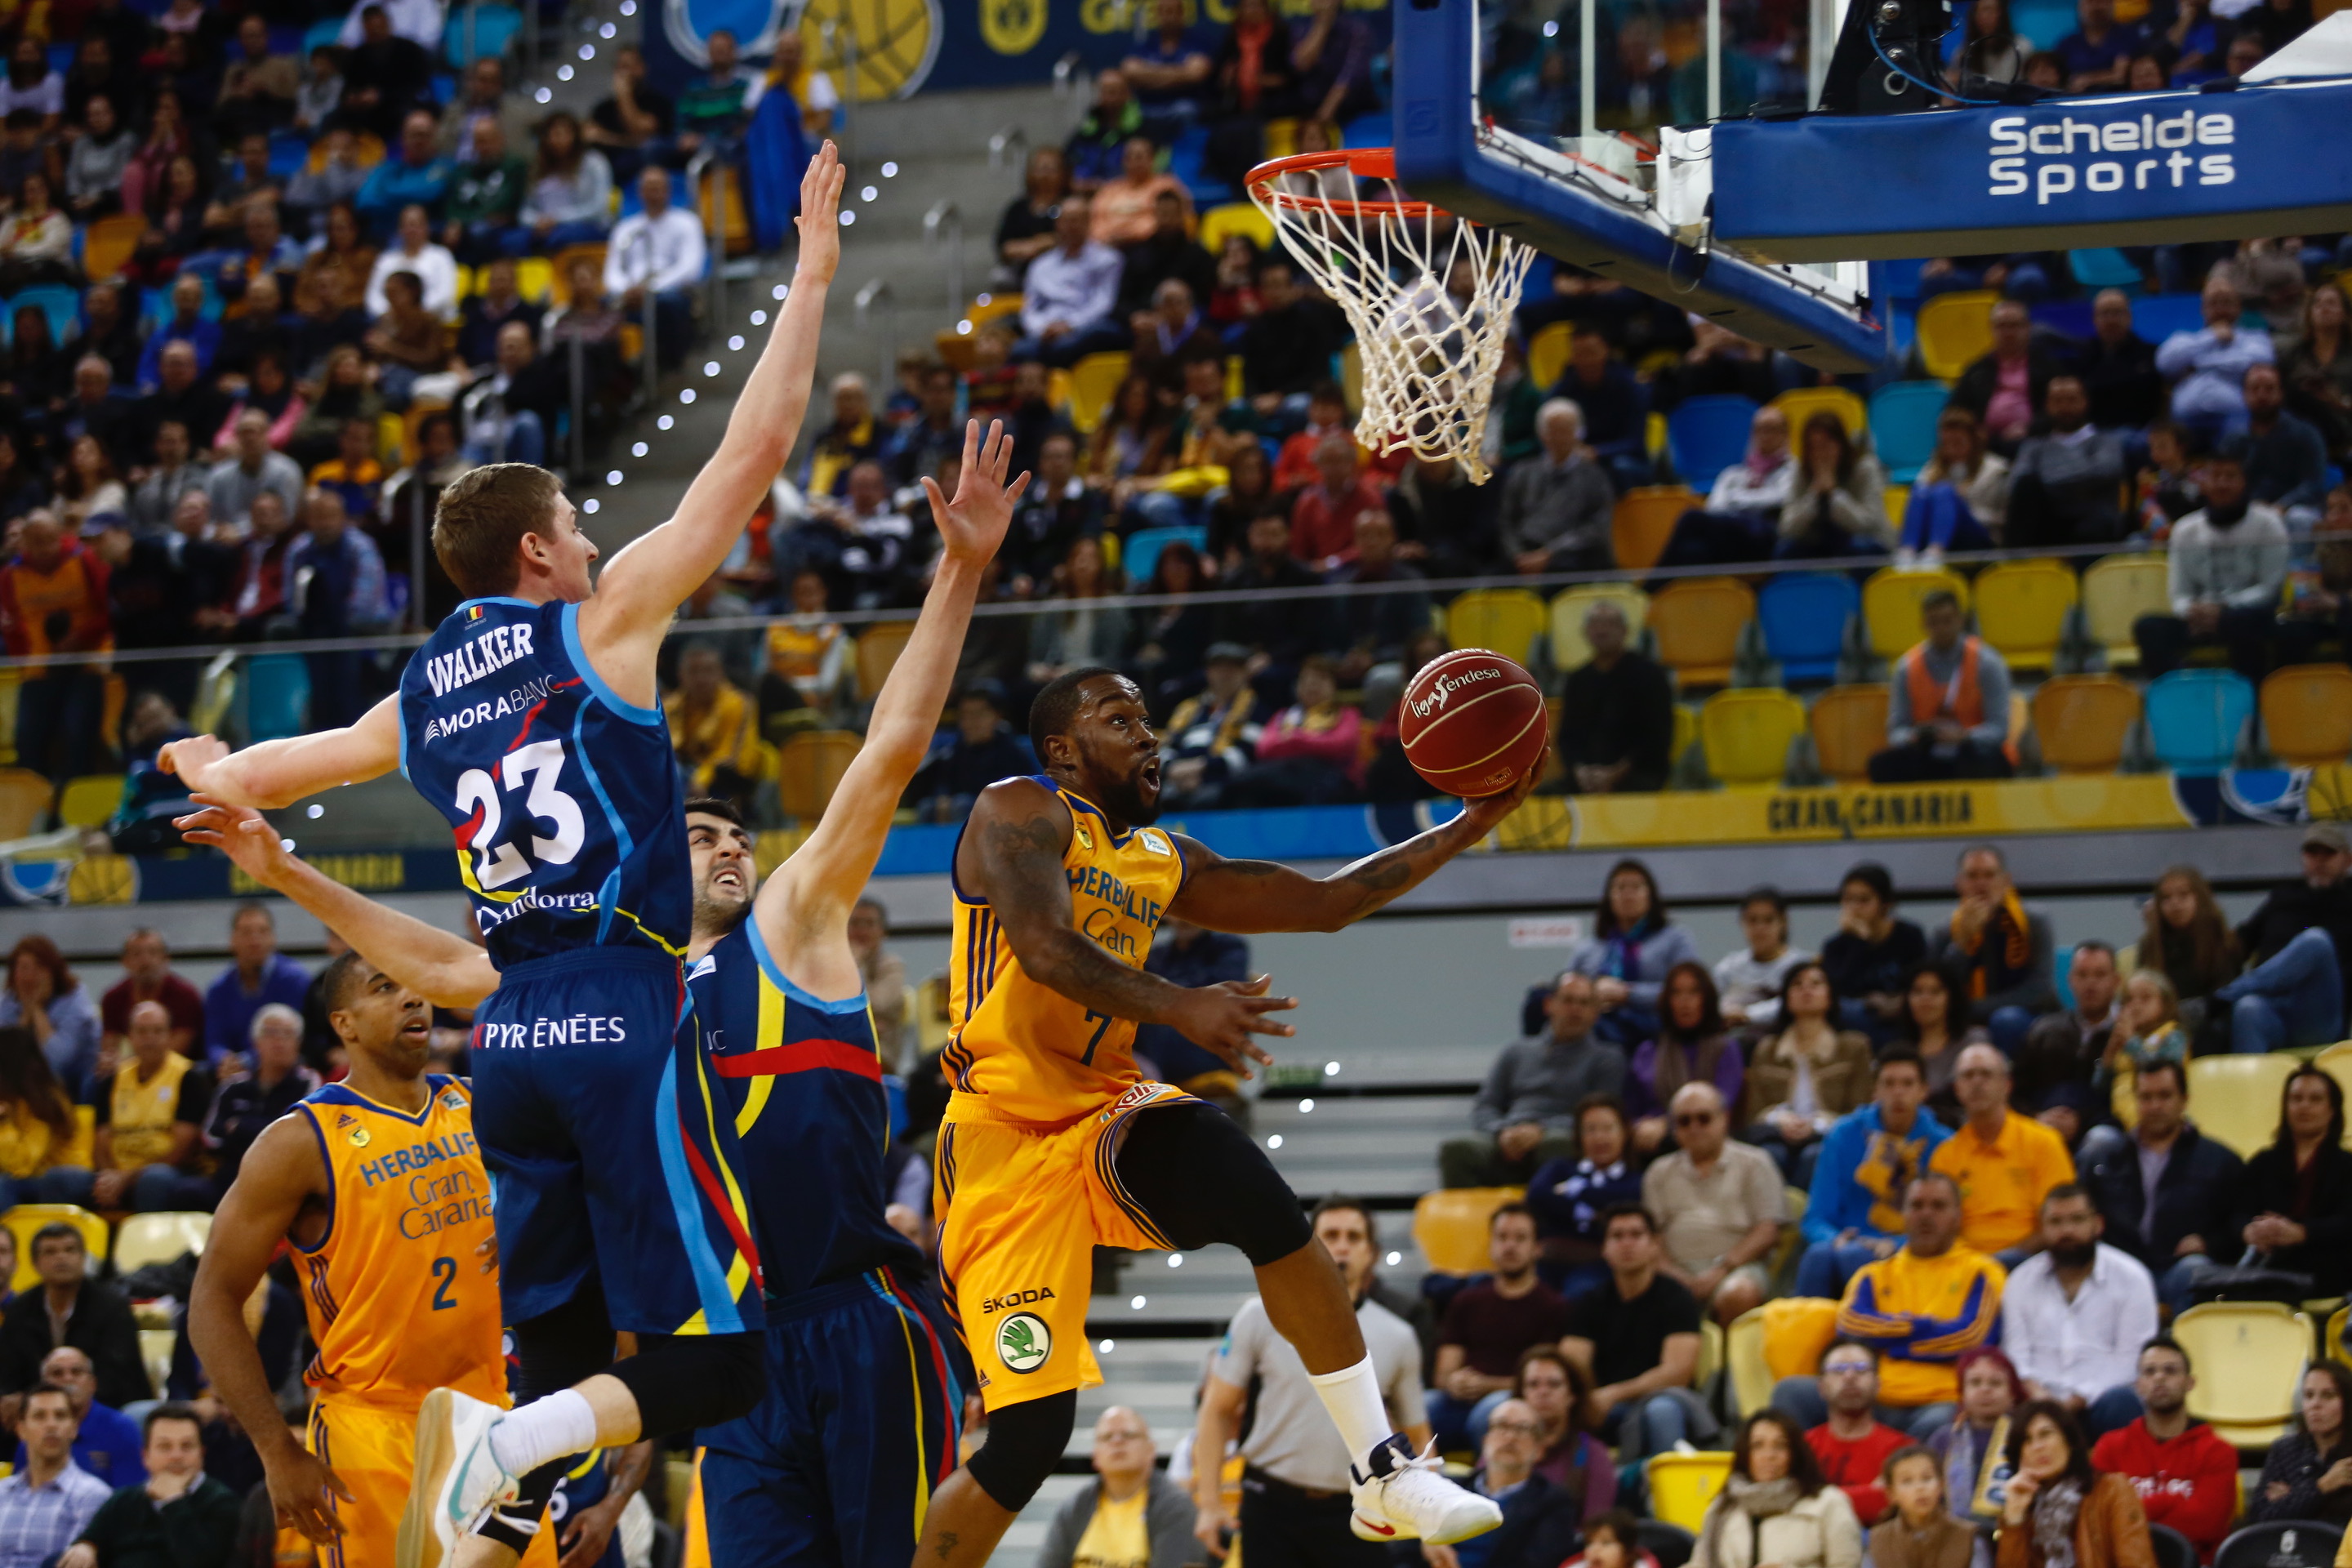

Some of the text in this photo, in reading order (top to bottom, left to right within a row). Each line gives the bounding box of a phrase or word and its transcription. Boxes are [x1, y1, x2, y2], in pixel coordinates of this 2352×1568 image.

[1989, 110, 2235, 156] Schelde
[1989, 150, 2236, 205] Sports
[426, 623, 534, 698] WALKER
[439, 674, 564, 737] MORABANC
[454, 738, 586, 890] 23
[1080, 1009, 1113, 1067] 7
[408, 1170, 472, 1206] Gran
[432, 1256, 457, 1311] 2
[982, 1286, 1056, 1314] ŠKODA
